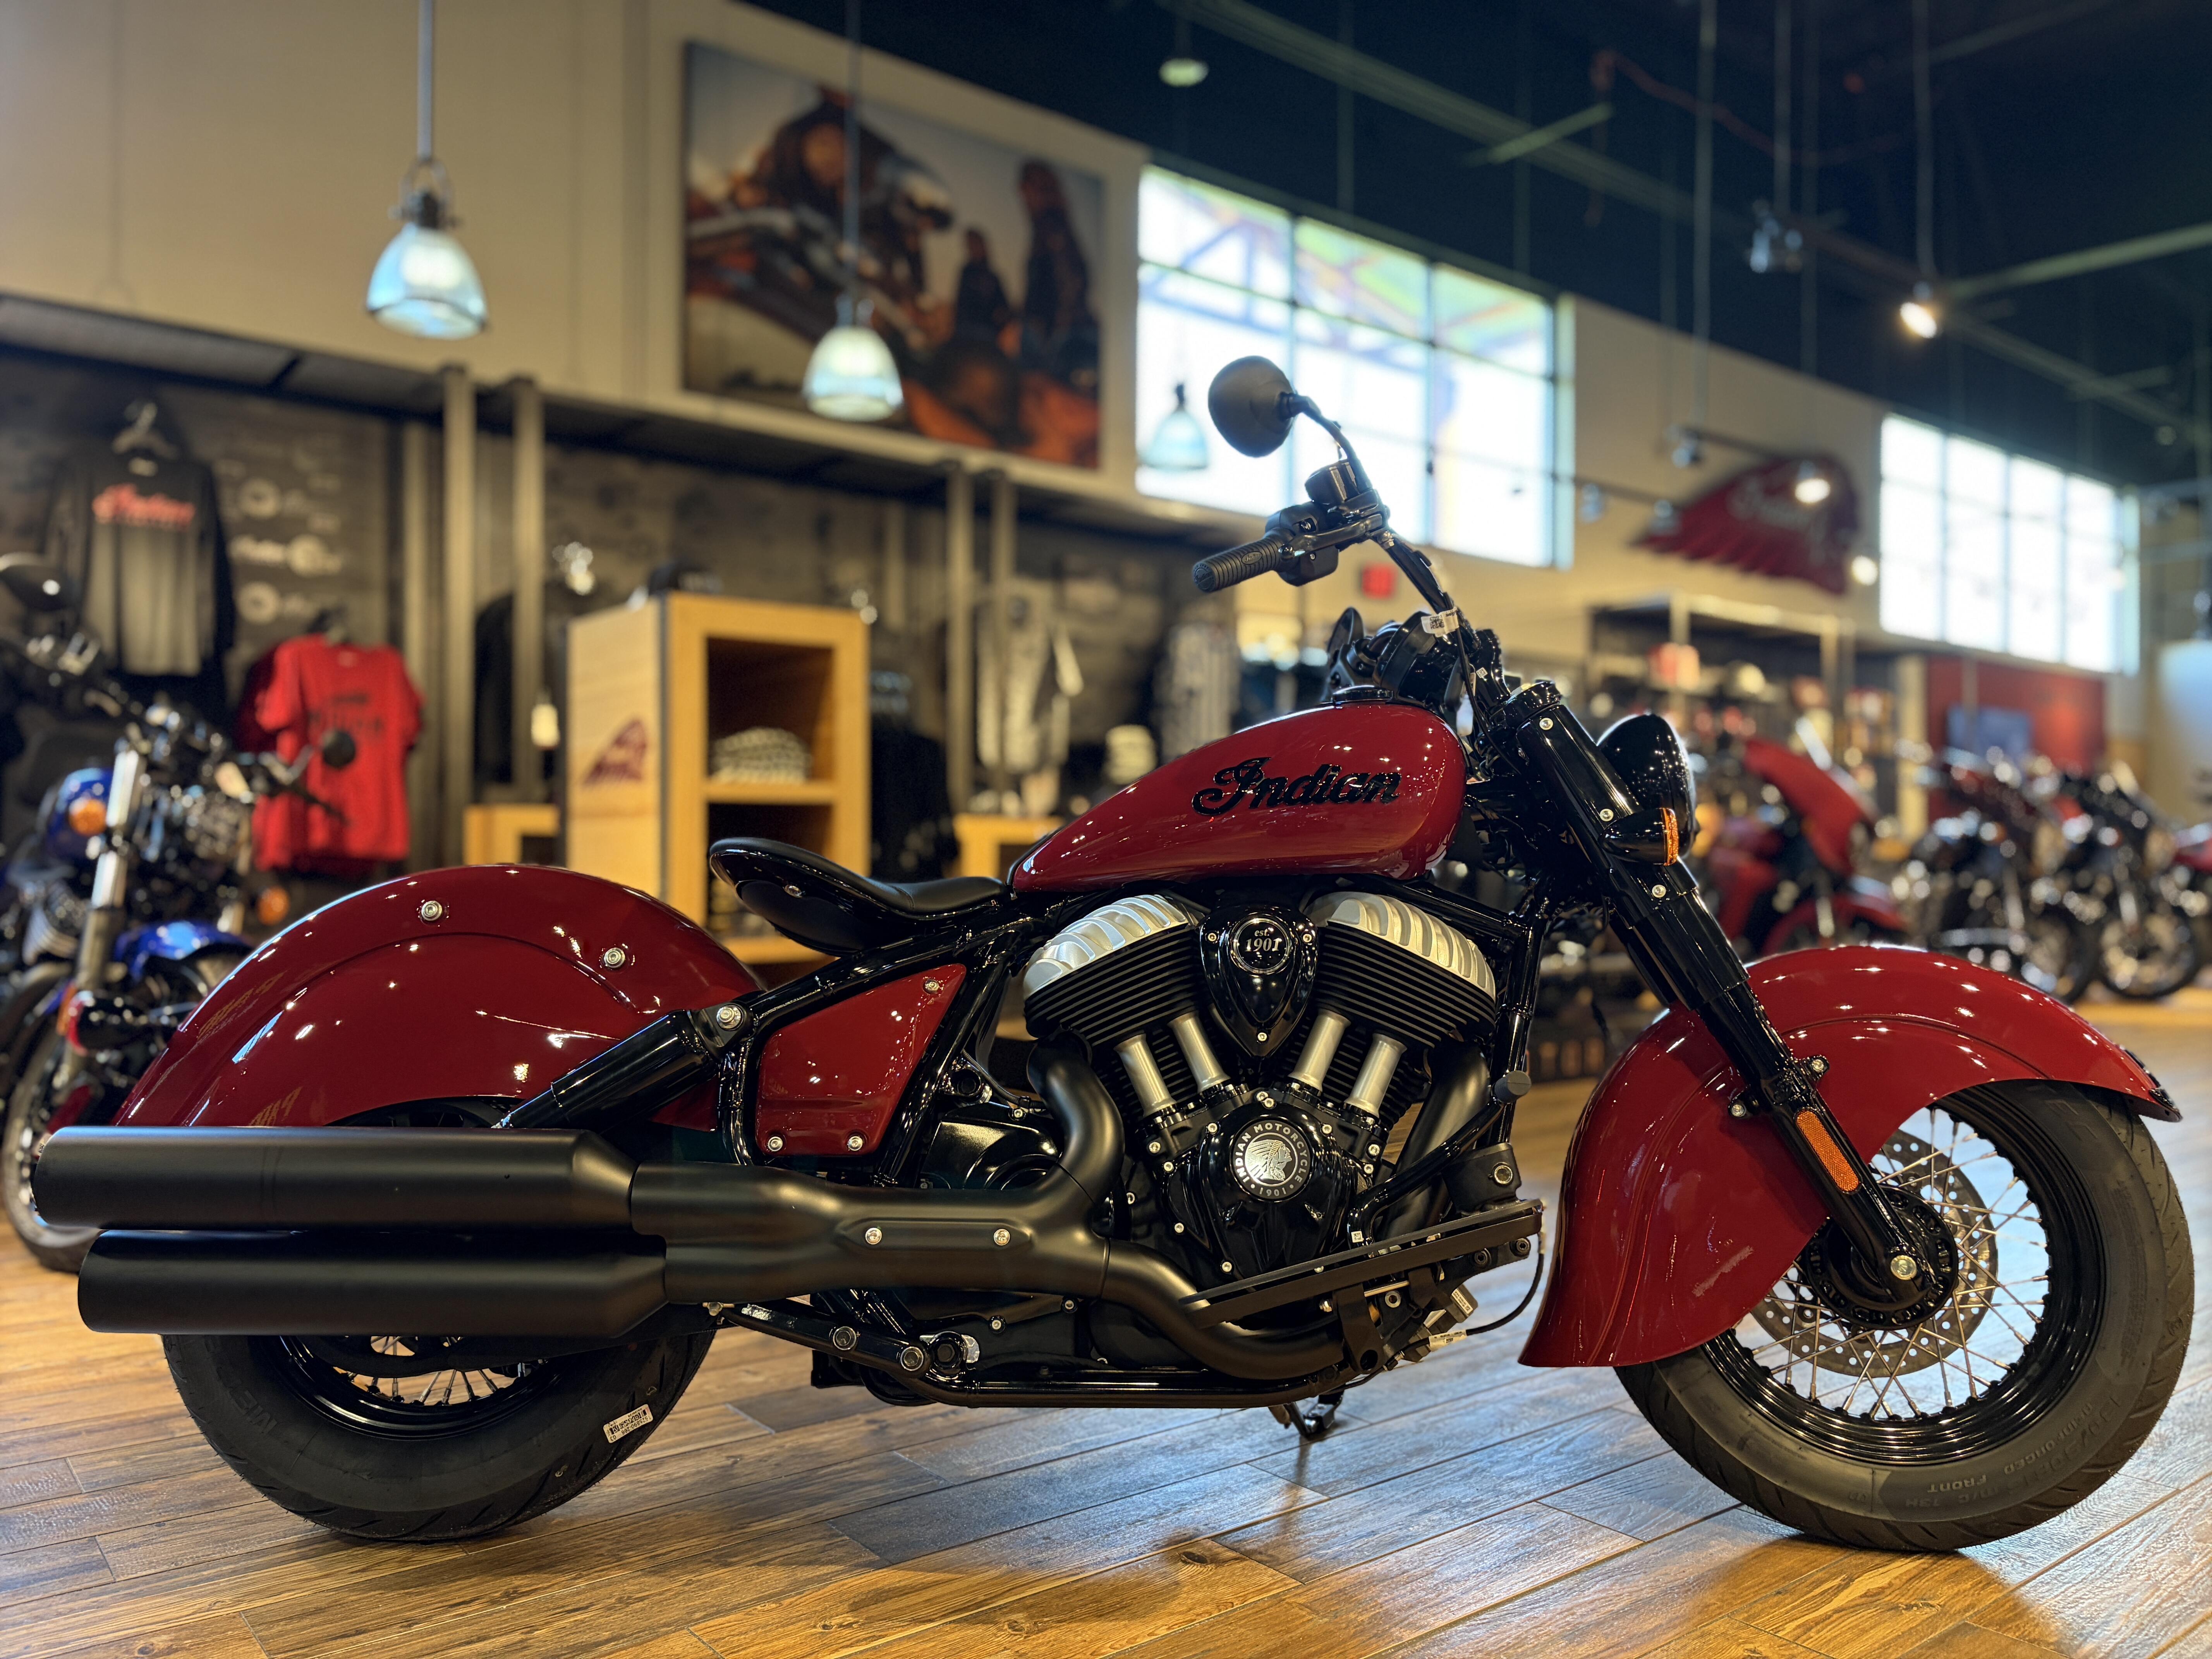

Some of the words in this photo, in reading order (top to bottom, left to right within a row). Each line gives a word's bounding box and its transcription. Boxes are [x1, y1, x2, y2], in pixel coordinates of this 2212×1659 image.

[1192, 757, 1401, 815] Indian
[1245, 938, 1280, 952] 1901
[1235, 1132, 1251, 1182] INDIAN
[1254, 1123, 1307, 1183] MOTORCYCLE
[1259, 1187, 1286, 1196] 1901
[1927, 1474, 1987, 1493] FRONT
